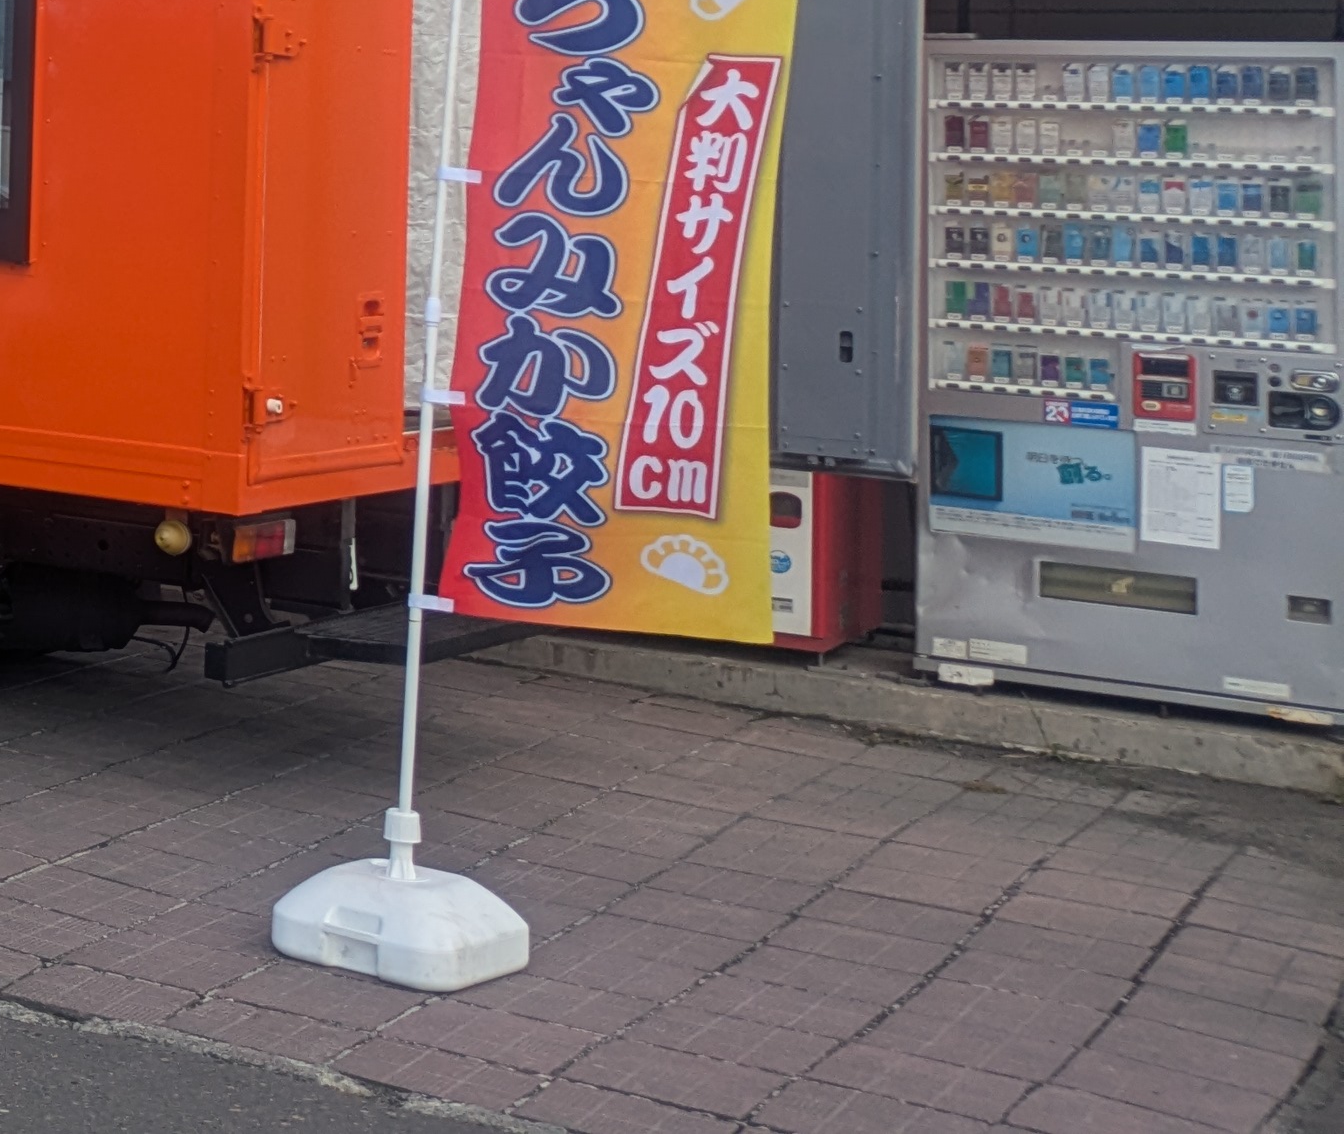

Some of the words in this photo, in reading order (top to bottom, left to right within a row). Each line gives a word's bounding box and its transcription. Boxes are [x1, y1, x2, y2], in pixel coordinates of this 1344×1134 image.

[628, 68, 762, 505] 大判サイズ10cm
